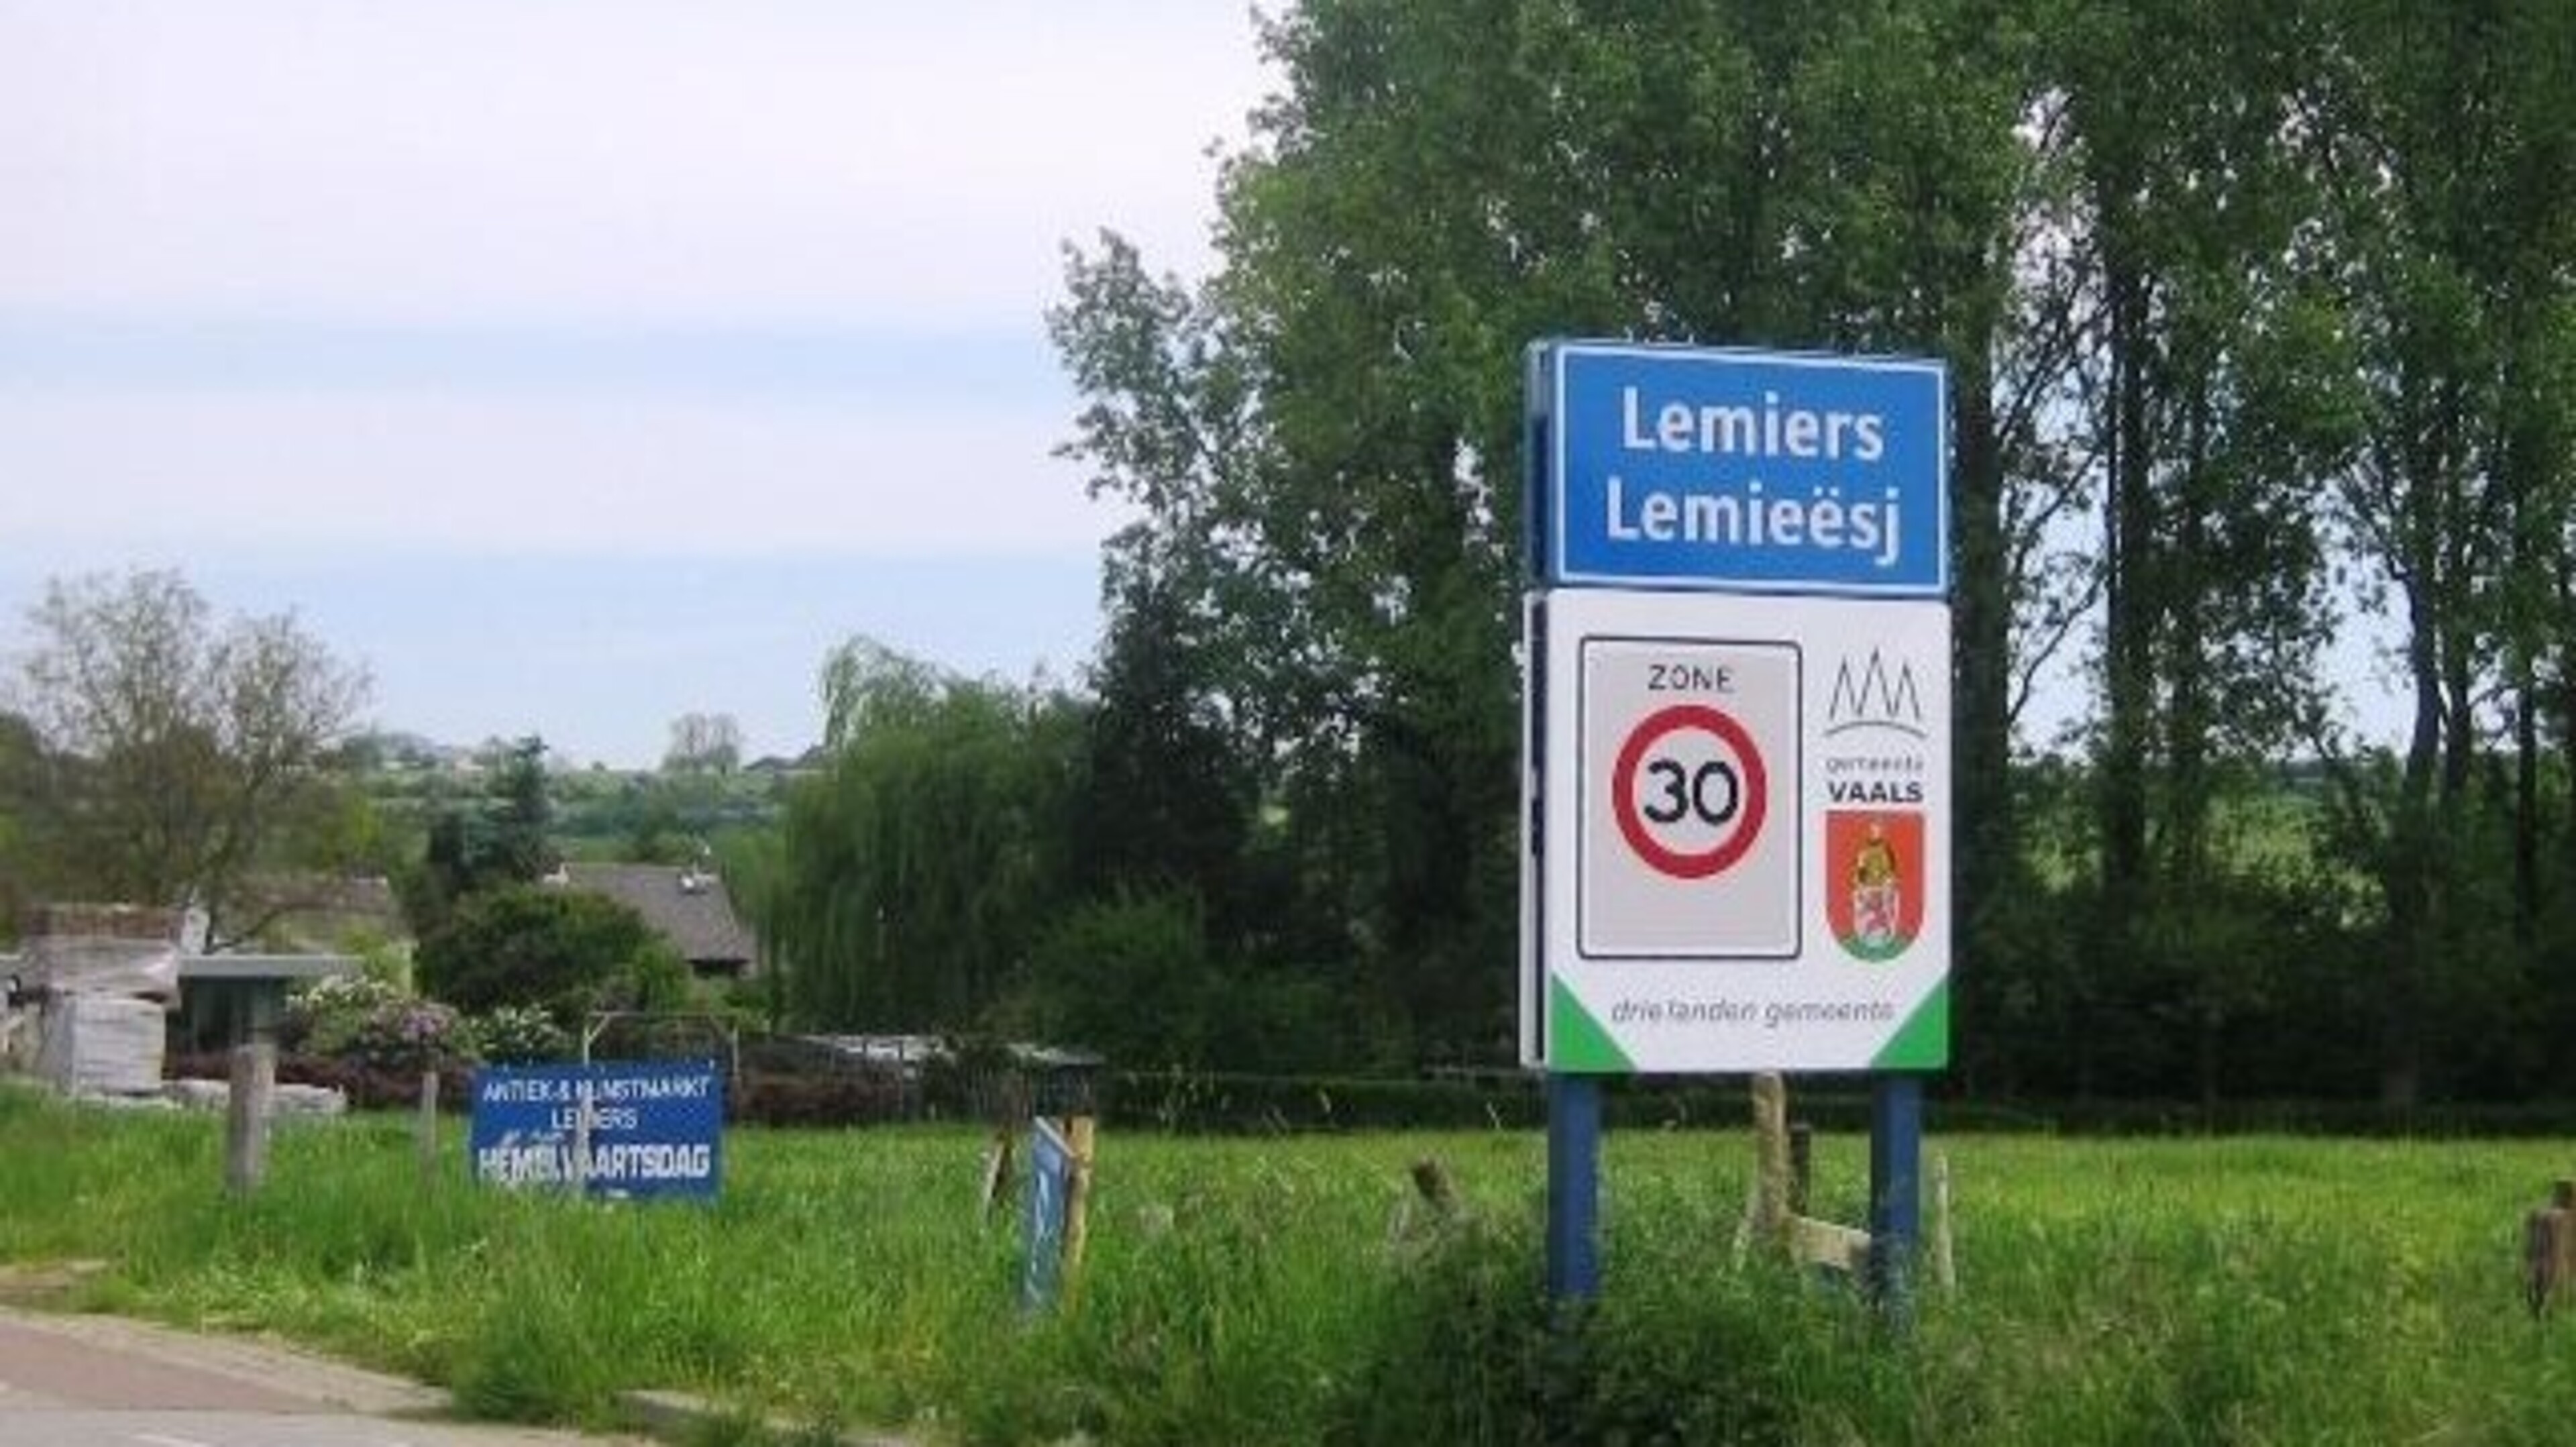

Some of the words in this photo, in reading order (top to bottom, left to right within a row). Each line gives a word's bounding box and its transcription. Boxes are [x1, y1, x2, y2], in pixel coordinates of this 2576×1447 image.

[1622, 386, 1884, 461] Lemiers
[1607, 475, 1900, 566] Lemieësj
[1648, 663, 1735, 693] ZONE
[1643, 759, 1739, 826] 30
[1827, 781, 1924, 803] VAALS
[551, 1108, 638, 1130] LEERS
